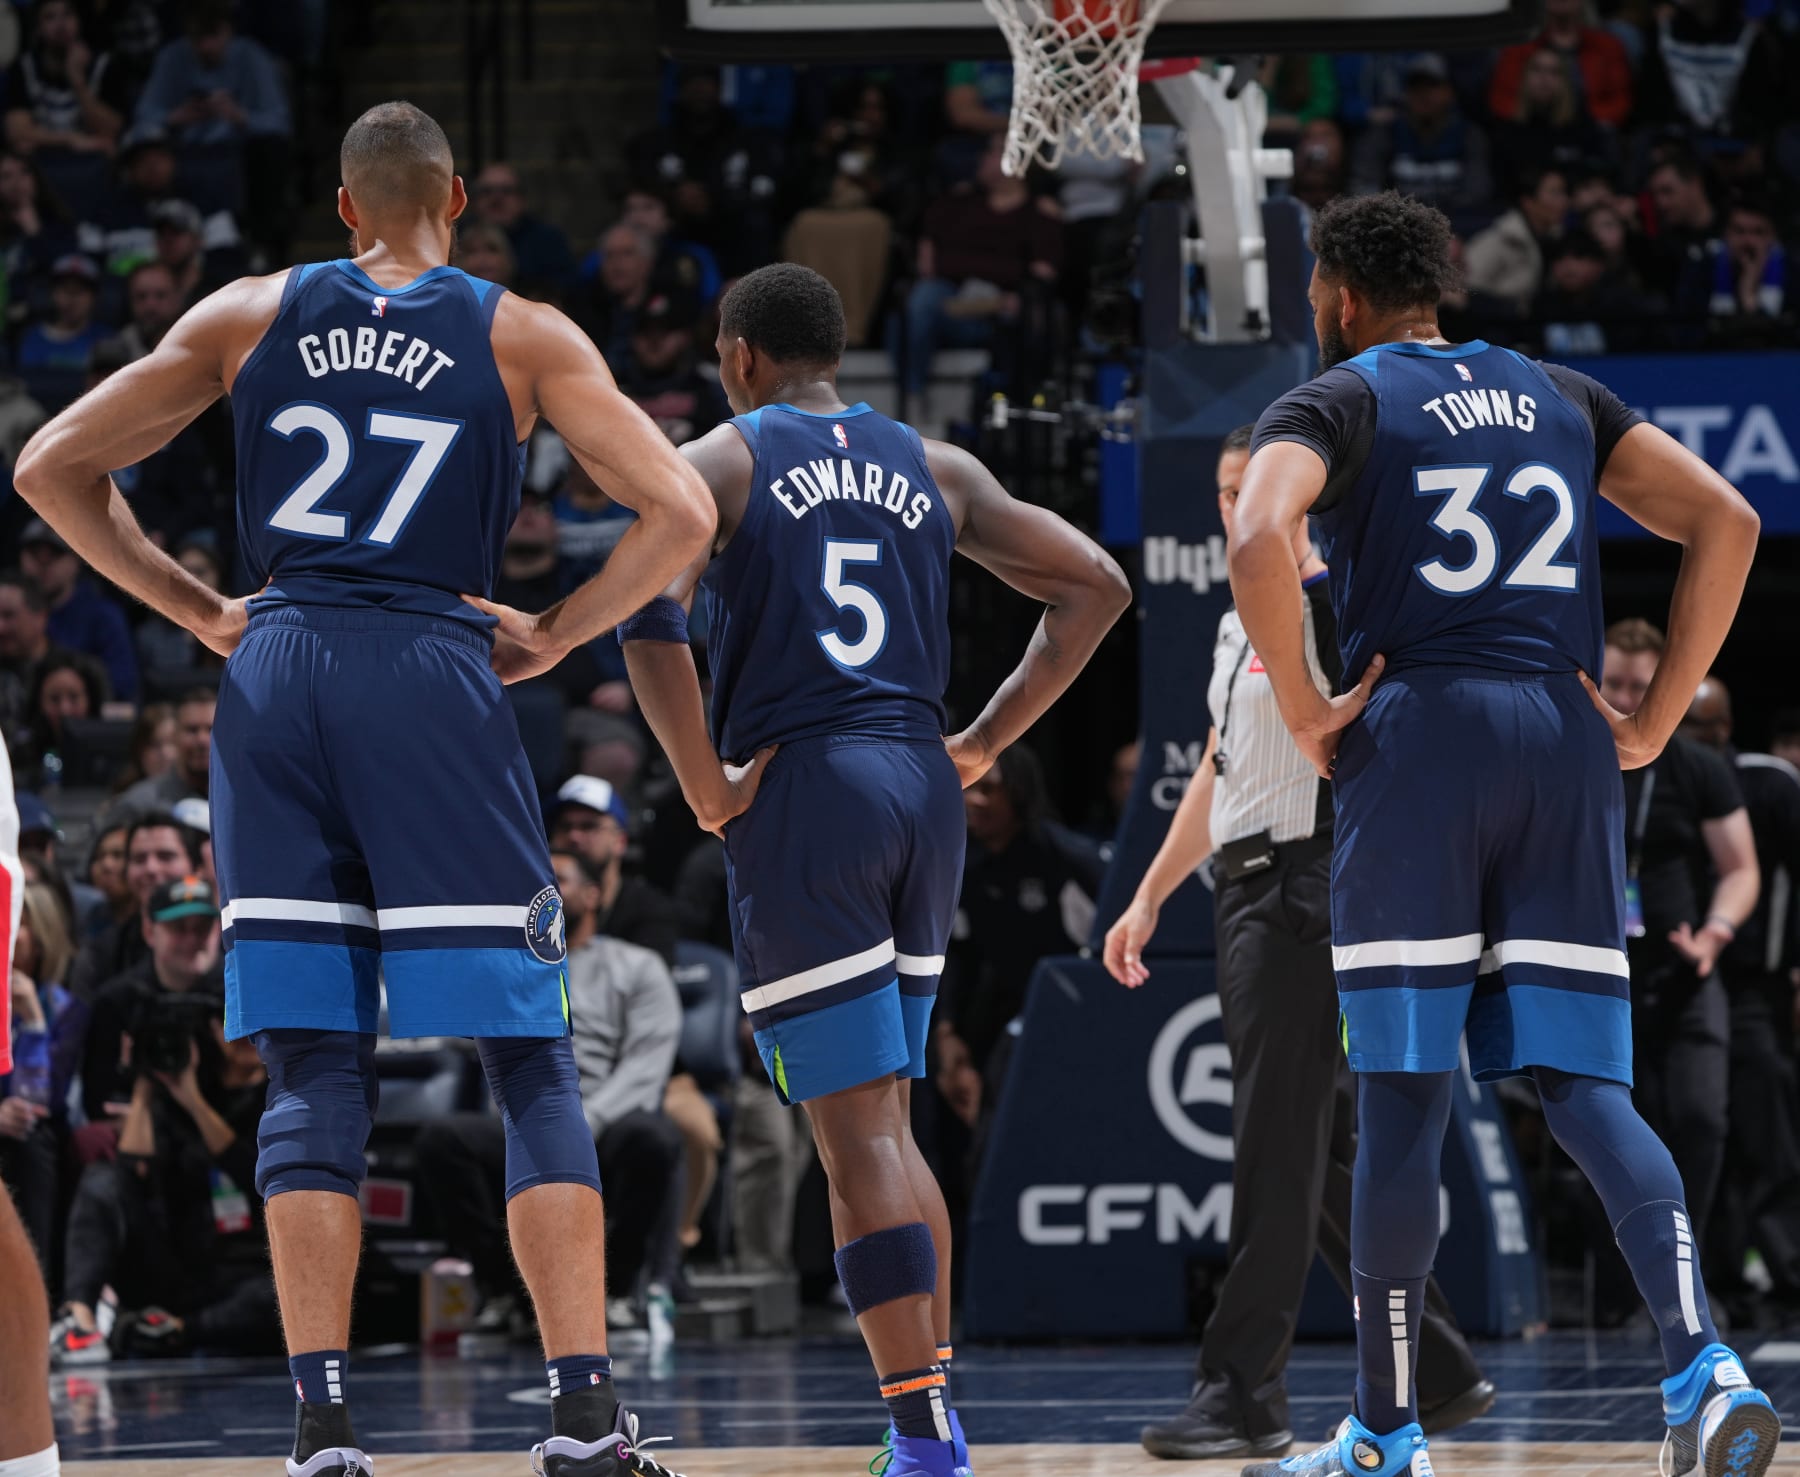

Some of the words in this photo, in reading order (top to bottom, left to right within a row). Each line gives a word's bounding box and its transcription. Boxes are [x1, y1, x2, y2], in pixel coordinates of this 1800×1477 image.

[297, 326, 455, 391] GOBERT
[1421, 388, 1537, 436] TOWNS
[266, 402, 464, 547] 27
[769, 457, 932, 530] EDWARDS
[1413, 462, 1580, 595] 32
[817, 537, 889, 670] 5
